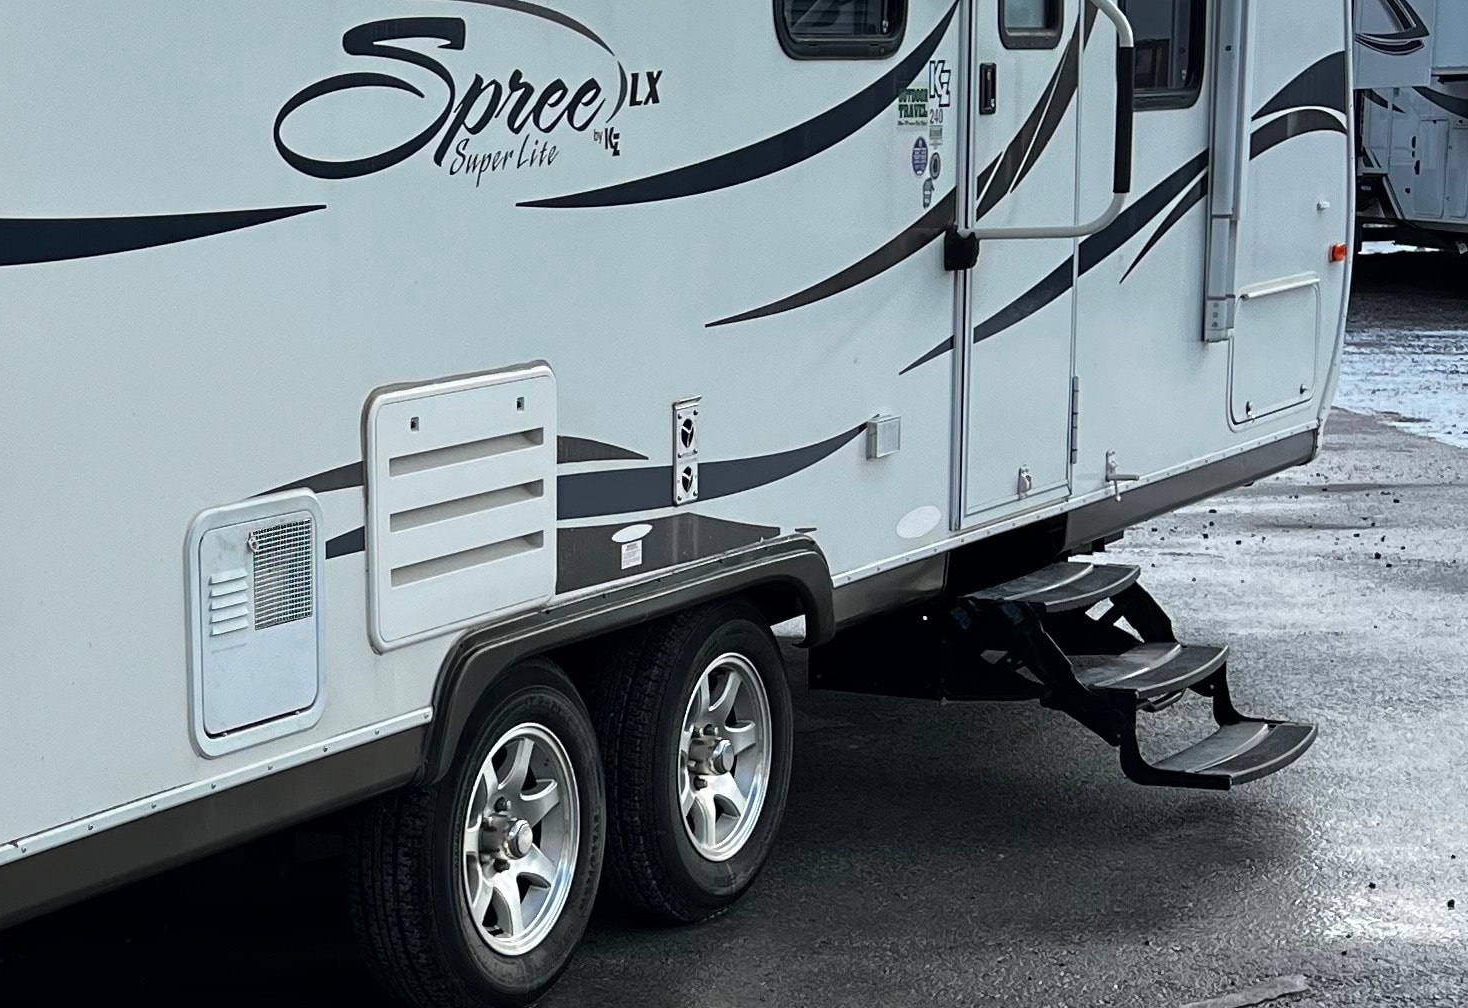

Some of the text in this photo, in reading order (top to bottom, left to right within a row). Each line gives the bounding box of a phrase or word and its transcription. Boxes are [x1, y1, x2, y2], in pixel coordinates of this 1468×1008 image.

[273, 17, 663, 179] Spree LX
[929, 108, 943, 124] 240
[593, 128, 603, 145] by
